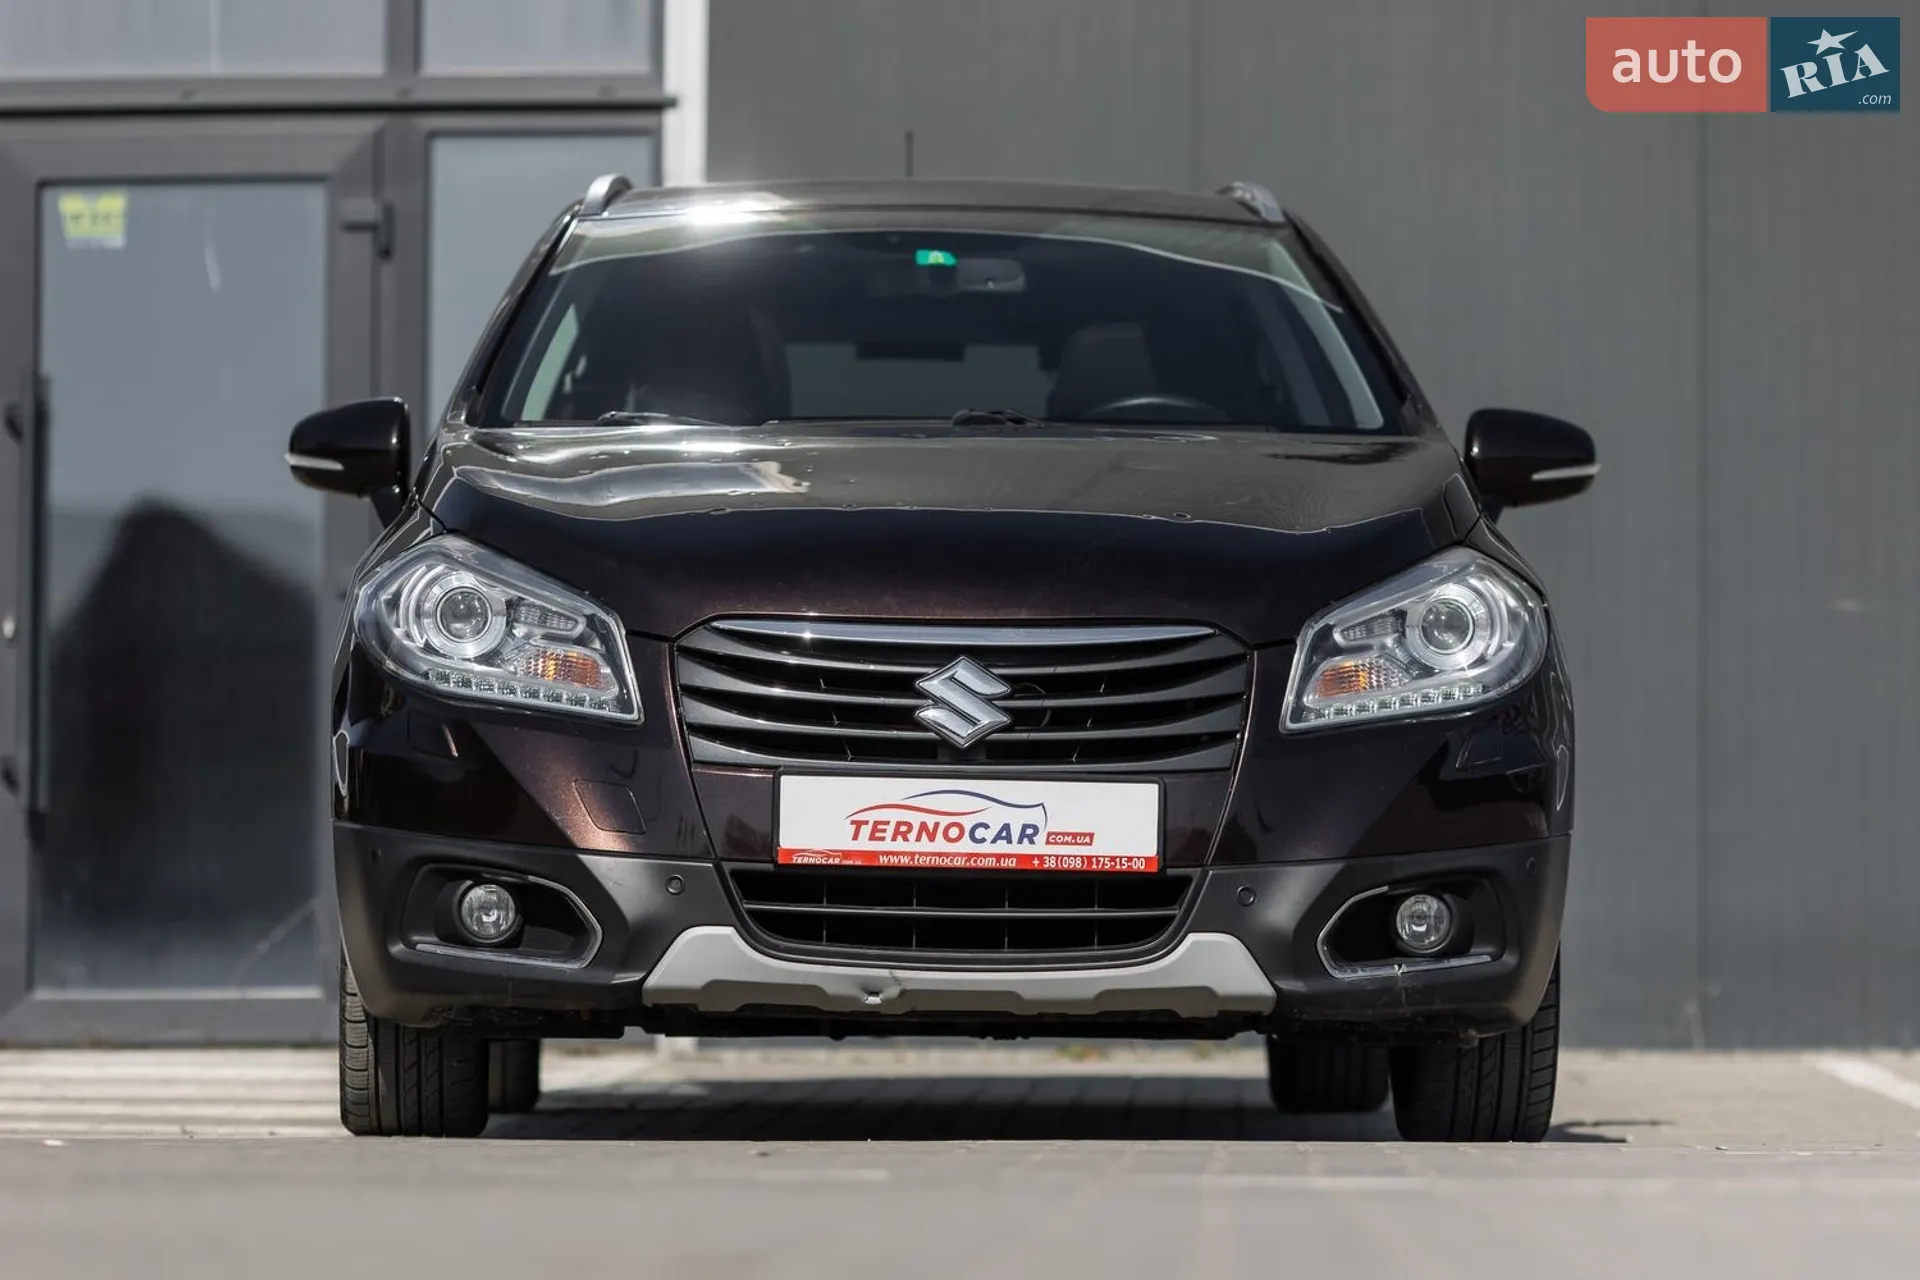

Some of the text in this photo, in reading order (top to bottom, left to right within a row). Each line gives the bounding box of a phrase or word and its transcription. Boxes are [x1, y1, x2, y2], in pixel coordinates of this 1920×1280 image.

[850, 819, 1091, 845] TERNOCAR COM.UA
[792, 856, 840, 864] TERNOCAR
[879, 853, 1016, 867] www.ternocar.com.ua
[1092, 857, 1146, 870] 175-15-00
